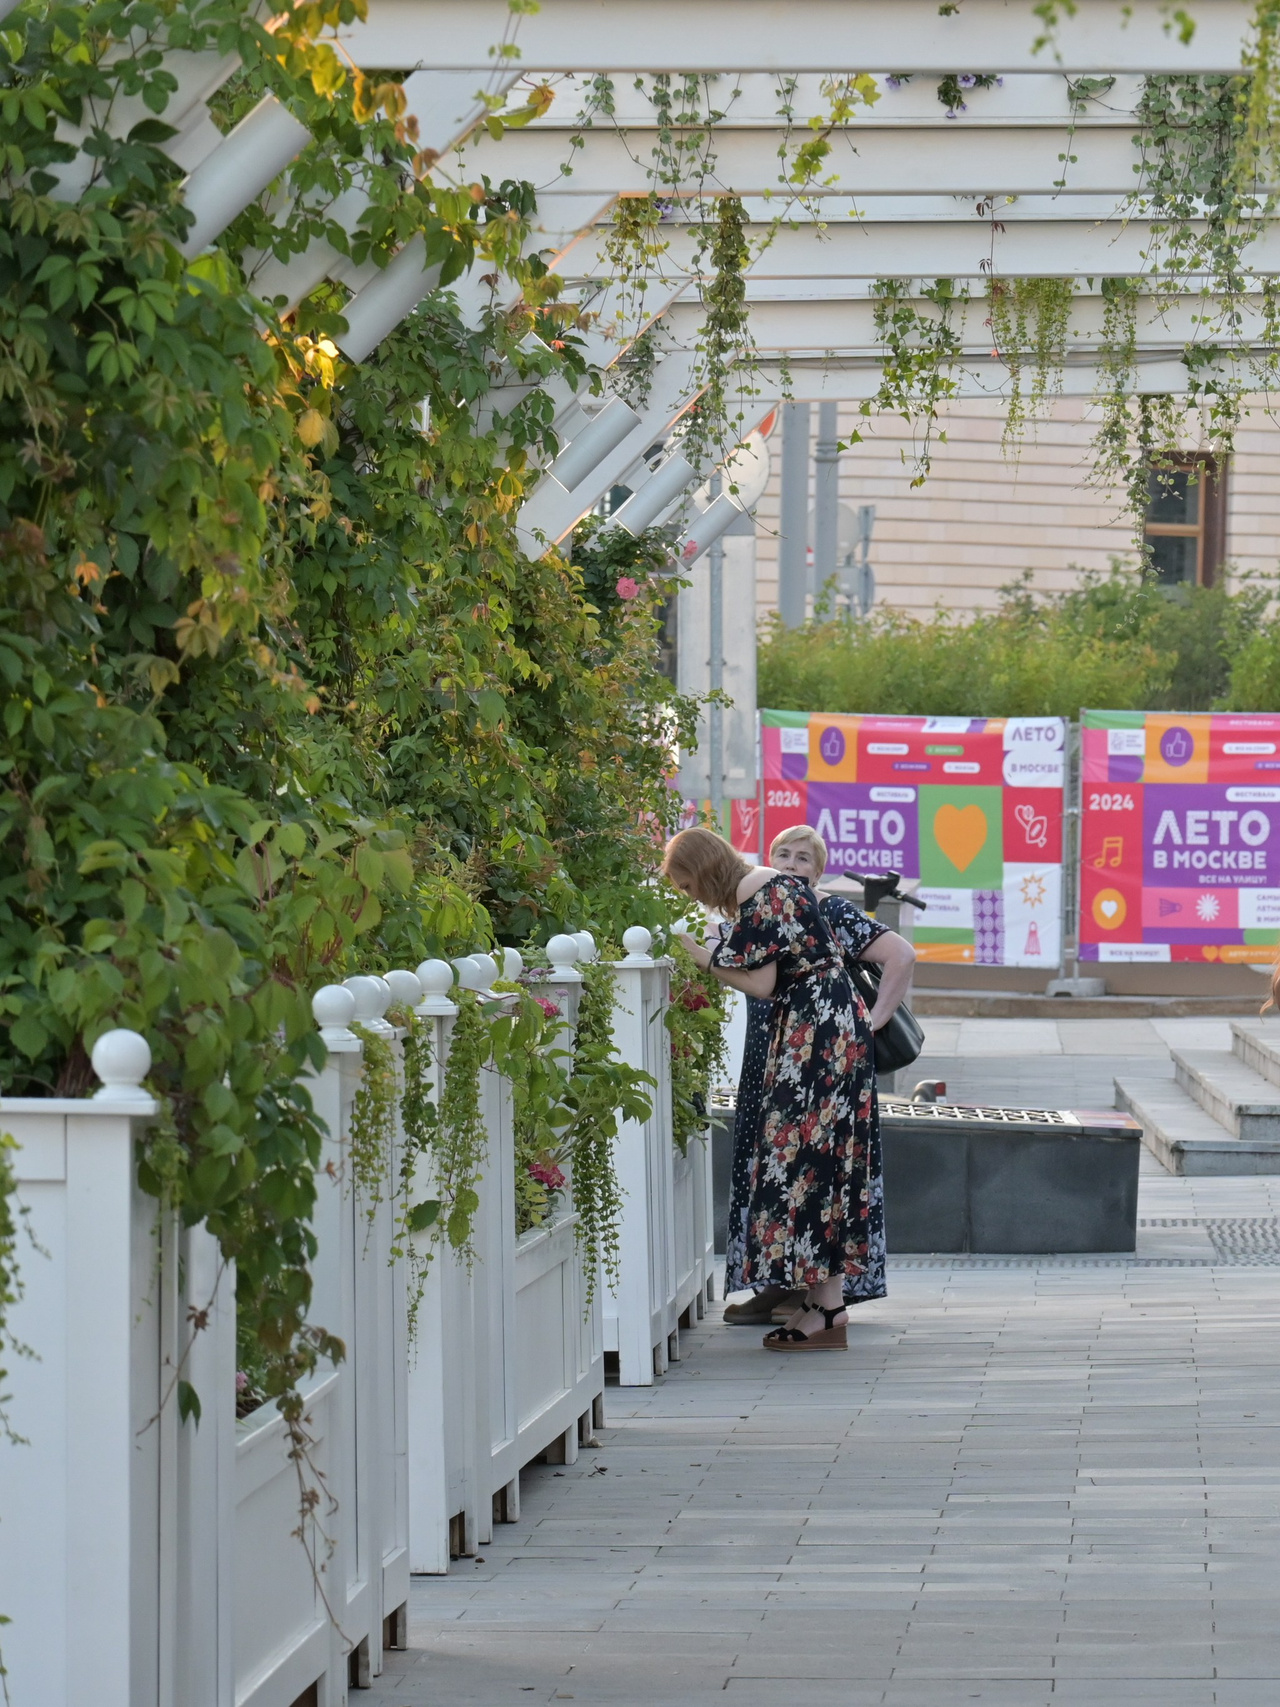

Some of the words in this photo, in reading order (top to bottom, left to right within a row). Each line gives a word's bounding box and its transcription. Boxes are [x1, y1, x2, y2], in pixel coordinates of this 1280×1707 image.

[1012, 726, 1057, 742] ЛЕТО
[1011, 763, 1017, 773] В
[1020, 763, 1060, 774] МОСКВЕ
[767, 790, 800, 808] 2024
[1089, 793, 1135, 811] 2024
[815, 808, 906, 846] ЛЕТО
[1152, 809, 1271, 846] ЛЕТО
[830, 848, 904, 868] МОСКВЕ
[1153, 850, 1168, 869] В
[1173, 850, 1267, 870] МОСКВЕ
[1199, 875, 1217, 884] ВСЕ
[1218, 875, 1231, 883] НА
